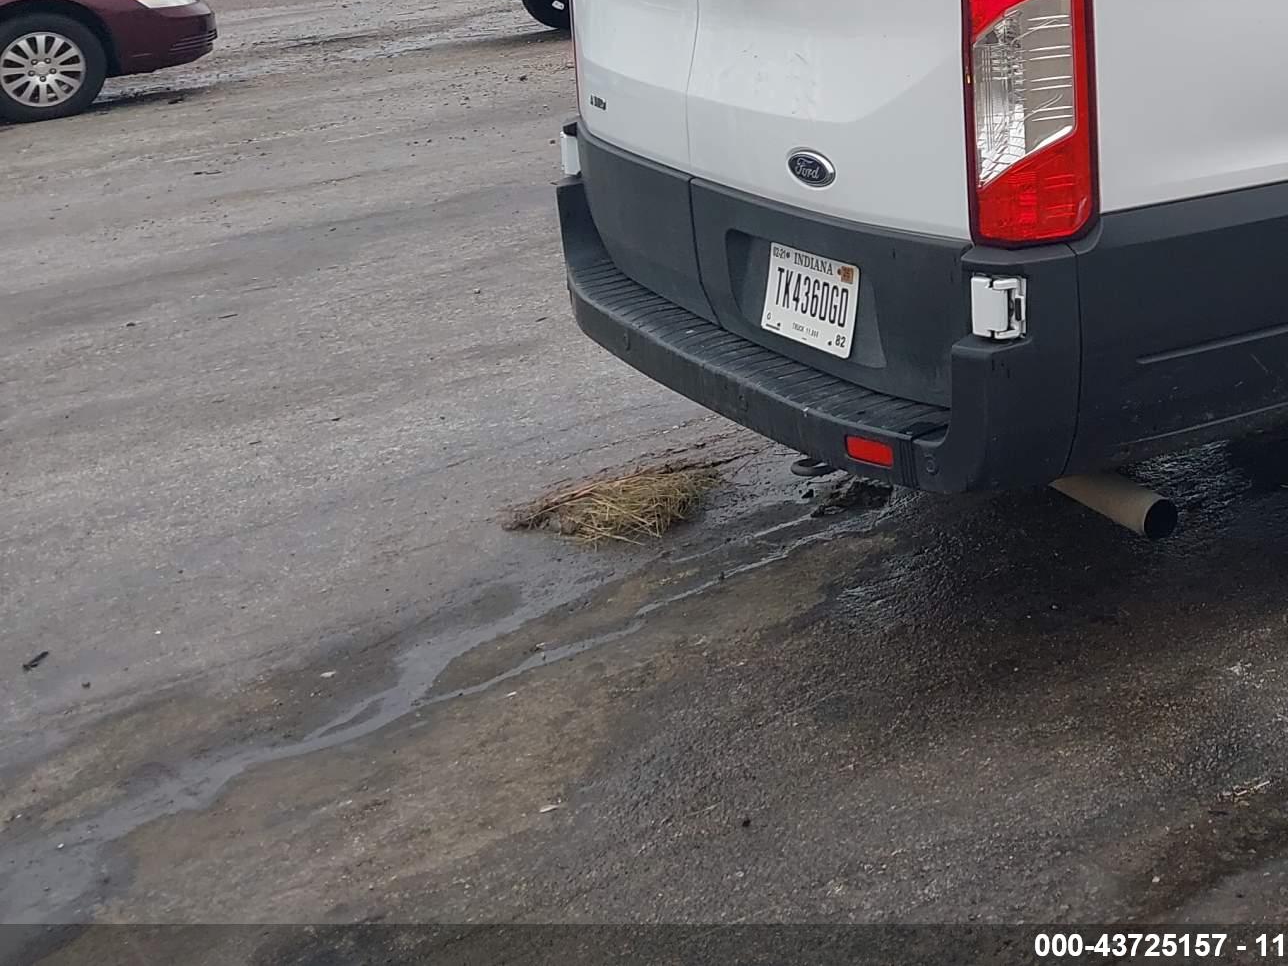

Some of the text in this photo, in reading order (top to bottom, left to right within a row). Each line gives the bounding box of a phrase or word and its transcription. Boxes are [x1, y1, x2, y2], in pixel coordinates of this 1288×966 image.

[794, 157, 820, 180] Ford
[793, 252, 834, 276] INDIANA
[835, 334, 846, 348] 82
